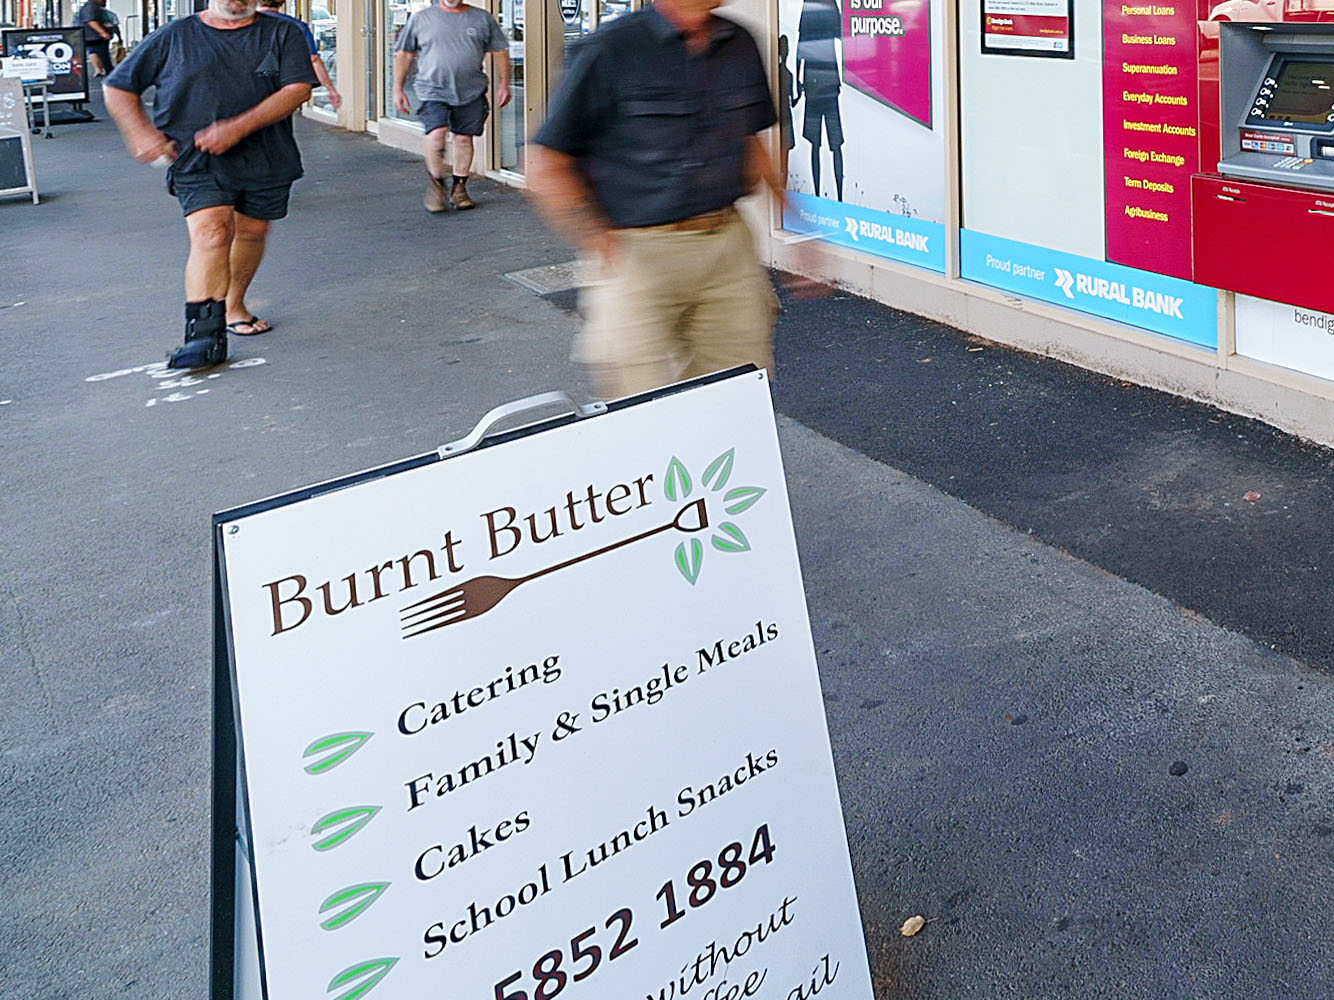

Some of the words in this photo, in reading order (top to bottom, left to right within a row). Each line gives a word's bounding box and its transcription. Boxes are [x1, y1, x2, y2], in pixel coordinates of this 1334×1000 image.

[1121, 5, 1151, 16] Personal
[1153, 5, 1175, 16] Loans
[851, 16, 904, 38] purpose.
[1122, 34, 1152, 45] Business
[1153, 35, 1176, 46] Loans
[1122, 62, 1177, 75] Superannuation
[1122, 91, 1153, 105] Everyday
[1154, 93, 1187, 106] Accounts
[1123, 119, 1161, 133] Investment
[1163, 123, 1196, 137] Accounts
[1123, 148, 1149, 163] Foreign
[1150, 151, 1185, 167] Exchange
[1124, 176, 1142, 188] Term
[1142, 179, 1174, 193] Deposits
[800, 209, 817, 224] Proud
[818, 215, 839, 229] partner
[1124, 205, 1168, 222] Agribusiness
[859, 220, 896, 244] RURAL
[895, 228, 929, 253] BANK
[986, 254, 1010, 272] Proud
[1012, 263, 1046, 281] partner
[1076, 273, 1130, 306] RURAL
[1132, 286, 1184, 320] BANK
[262, 529, 465, 638] Burnt
[480, 472, 656, 561] Butter
[397, 653, 562, 737] Catering
[403, 729, 543, 812] Family
[551, 710, 582, 743] &
[590, 659, 690, 724] Single
[694, 618, 780, 676] Meals
[413, 808, 532, 883] Cakes
[421, 864, 552, 960] School
[559, 805, 671, 883] Lunch
[676, 744, 780, 818] Snacks
[494, 907, 638, 1000] 5852
[655, 823, 776, 930] 1884
[645, 895, 799, 1000] without
